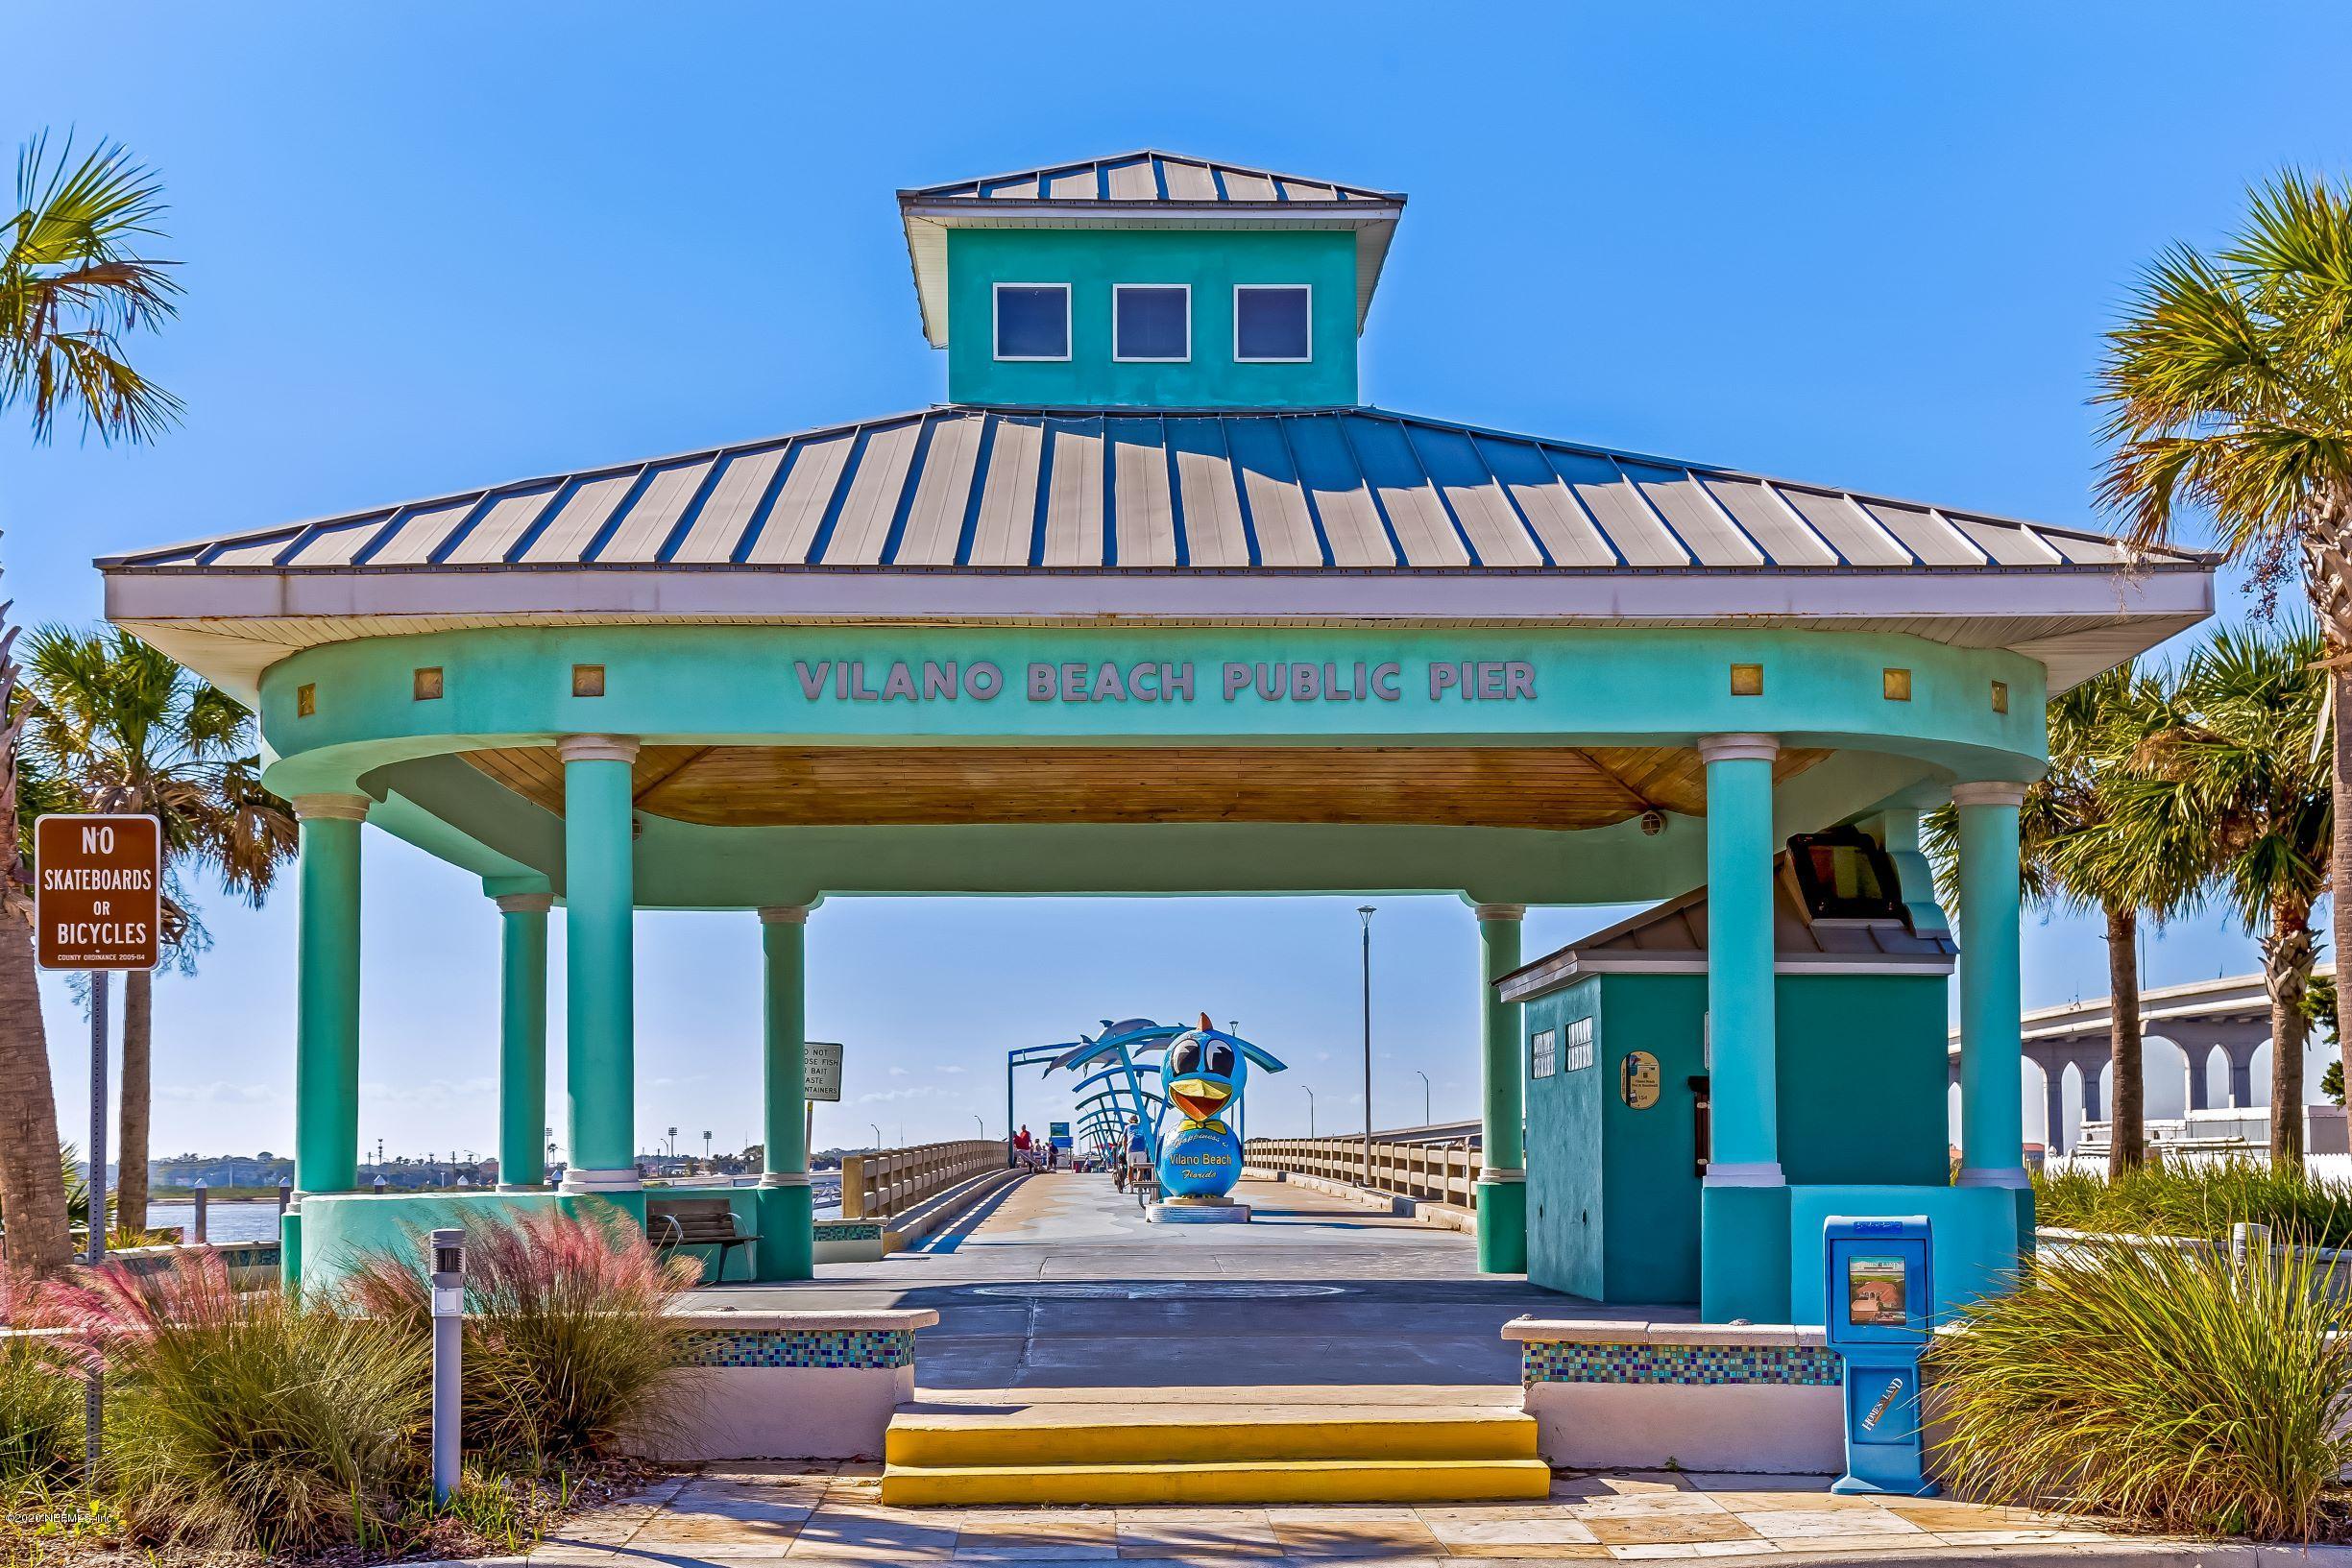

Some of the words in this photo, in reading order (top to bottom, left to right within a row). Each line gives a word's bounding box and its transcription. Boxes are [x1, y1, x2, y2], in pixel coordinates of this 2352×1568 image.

[793, 662, 1004, 701] VILANO
[1027, 662, 1194, 702] BEACH
[1223, 662, 1401, 702] PUBLIC
[1429, 662, 1538, 701] PIER
[82, 826, 114, 855] NO
[44, 869, 152, 891] SKATEBOARDS
[93, 901, 110, 916] OR
[58, 923, 147, 945] BICYCLES
[1169, 1153, 1200, 1165] Vilano
[1202, 1153, 1232, 1165] Beach
